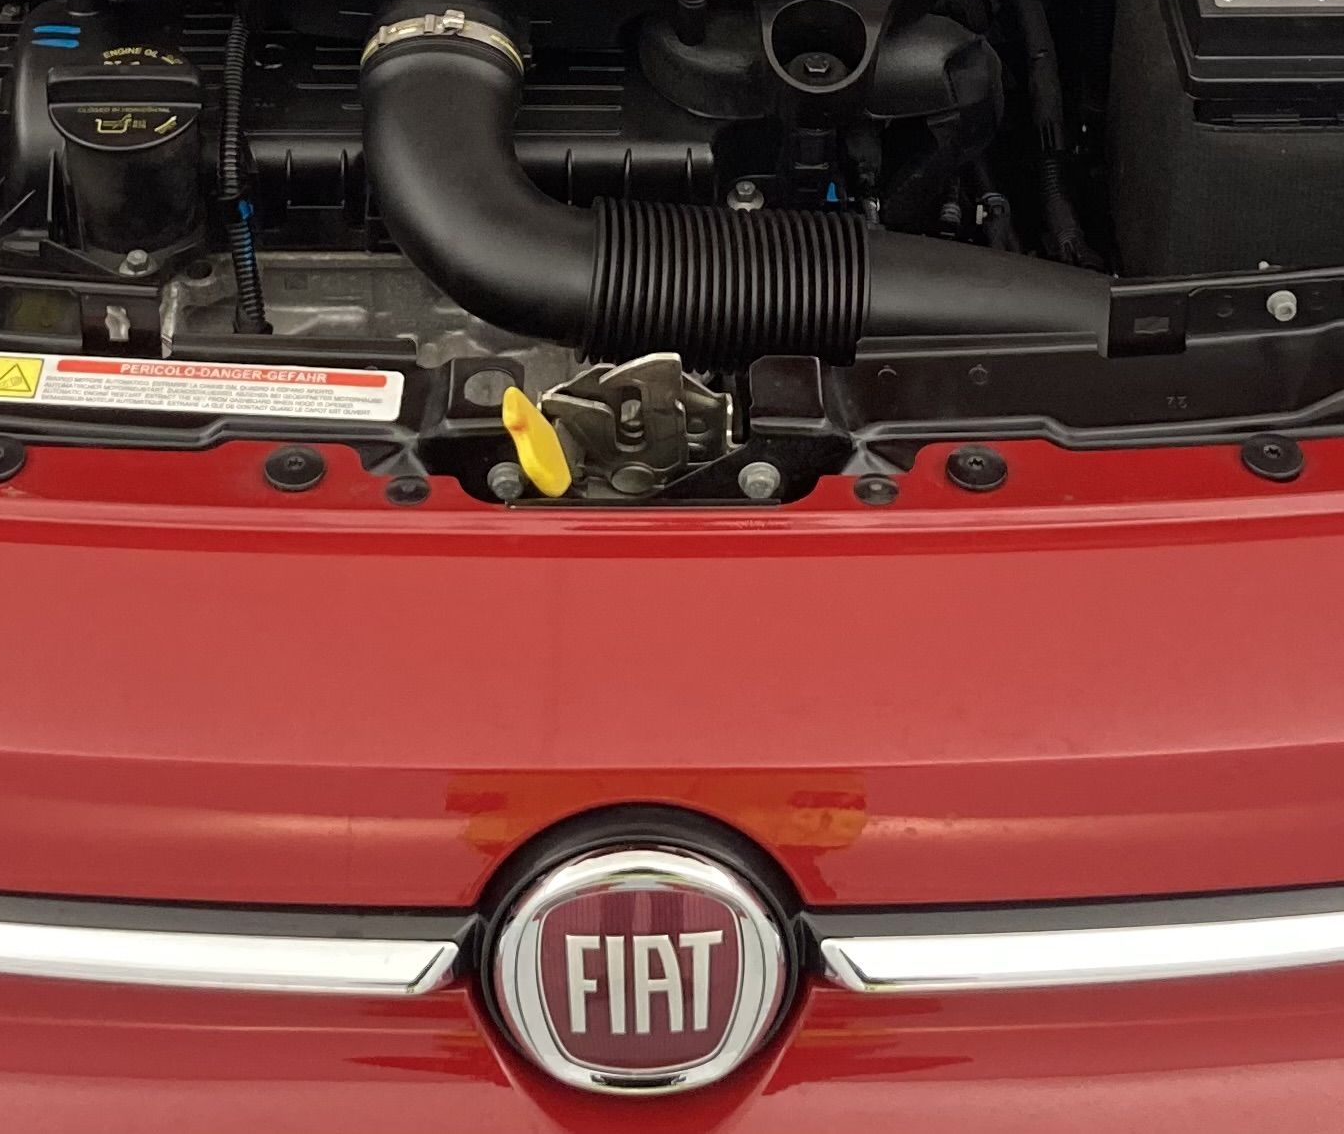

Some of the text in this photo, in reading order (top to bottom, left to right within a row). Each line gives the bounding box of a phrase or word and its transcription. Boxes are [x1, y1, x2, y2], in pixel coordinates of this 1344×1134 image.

[102, 47, 142, 59] ENGINE
[120, 364, 327, 383] PERICOLO-DANGER-GEFAHR
[565, 930, 724, 1036] FIAT
